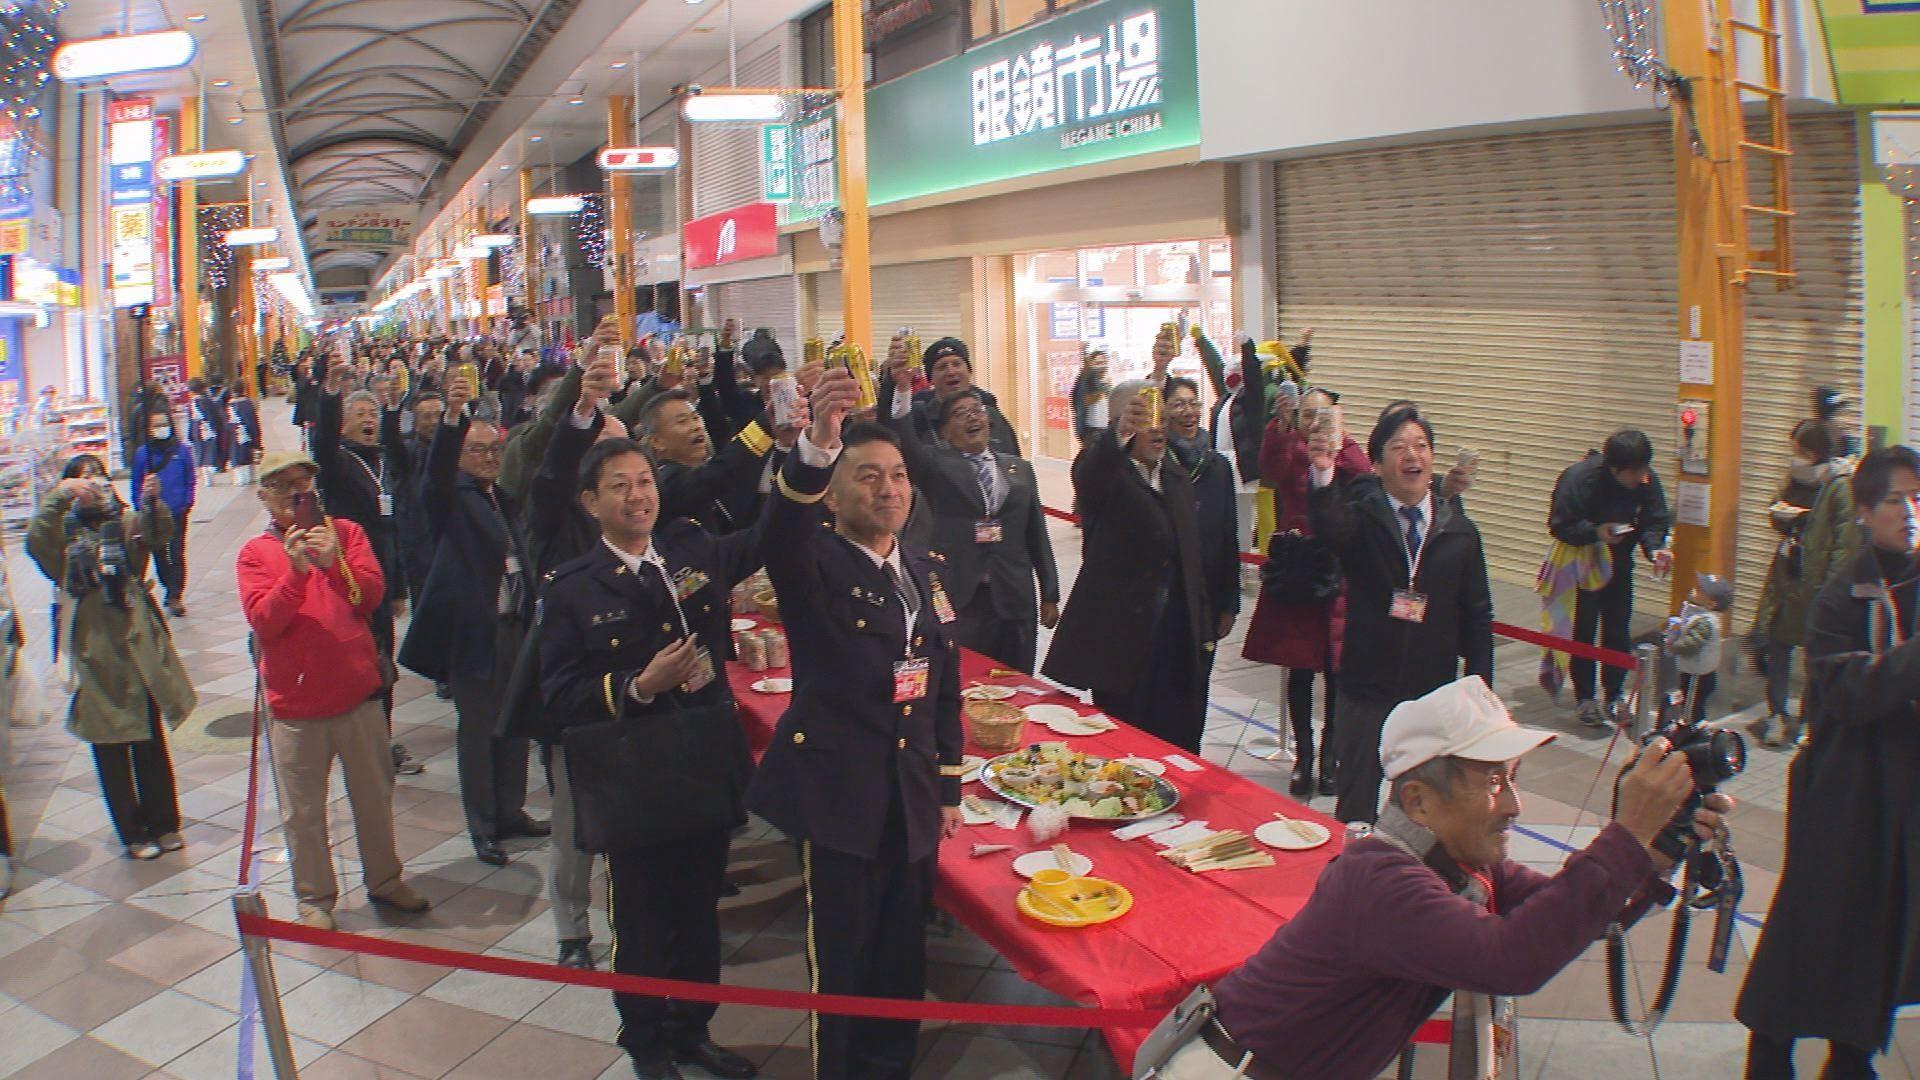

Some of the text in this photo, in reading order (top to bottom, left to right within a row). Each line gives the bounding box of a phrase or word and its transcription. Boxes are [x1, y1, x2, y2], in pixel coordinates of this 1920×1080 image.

[971, 10, 1160, 146] 眼鏡市場
[1060, 112, 1162, 150] MEGANE ICHIBA
